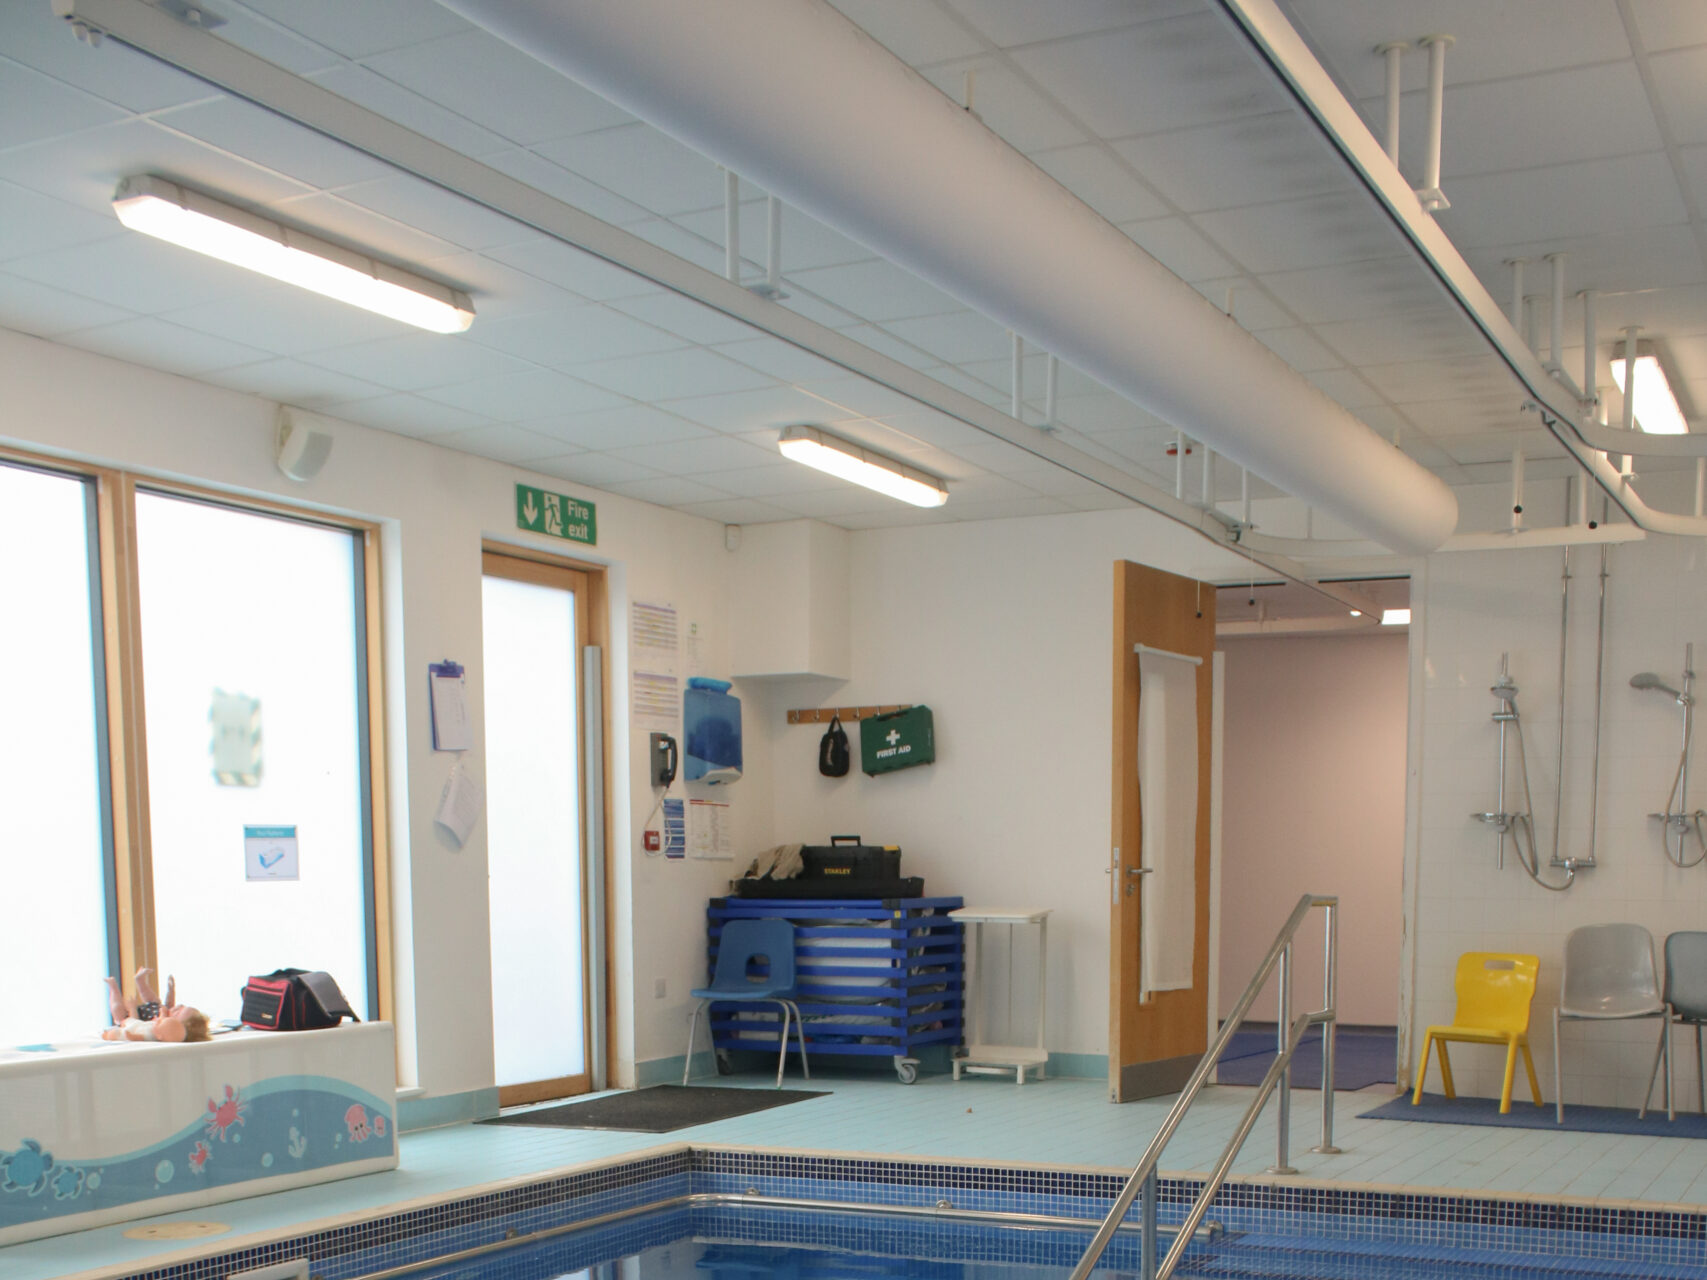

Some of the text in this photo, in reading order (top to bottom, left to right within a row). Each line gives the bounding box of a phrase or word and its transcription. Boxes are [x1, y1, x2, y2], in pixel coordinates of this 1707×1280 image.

[567, 498, 589, 520] Fire
[567, 523, 589, 540] exit
[876, 744, 911, 759] FIRST AID
[824, 867, 850, 875] STANLEY
